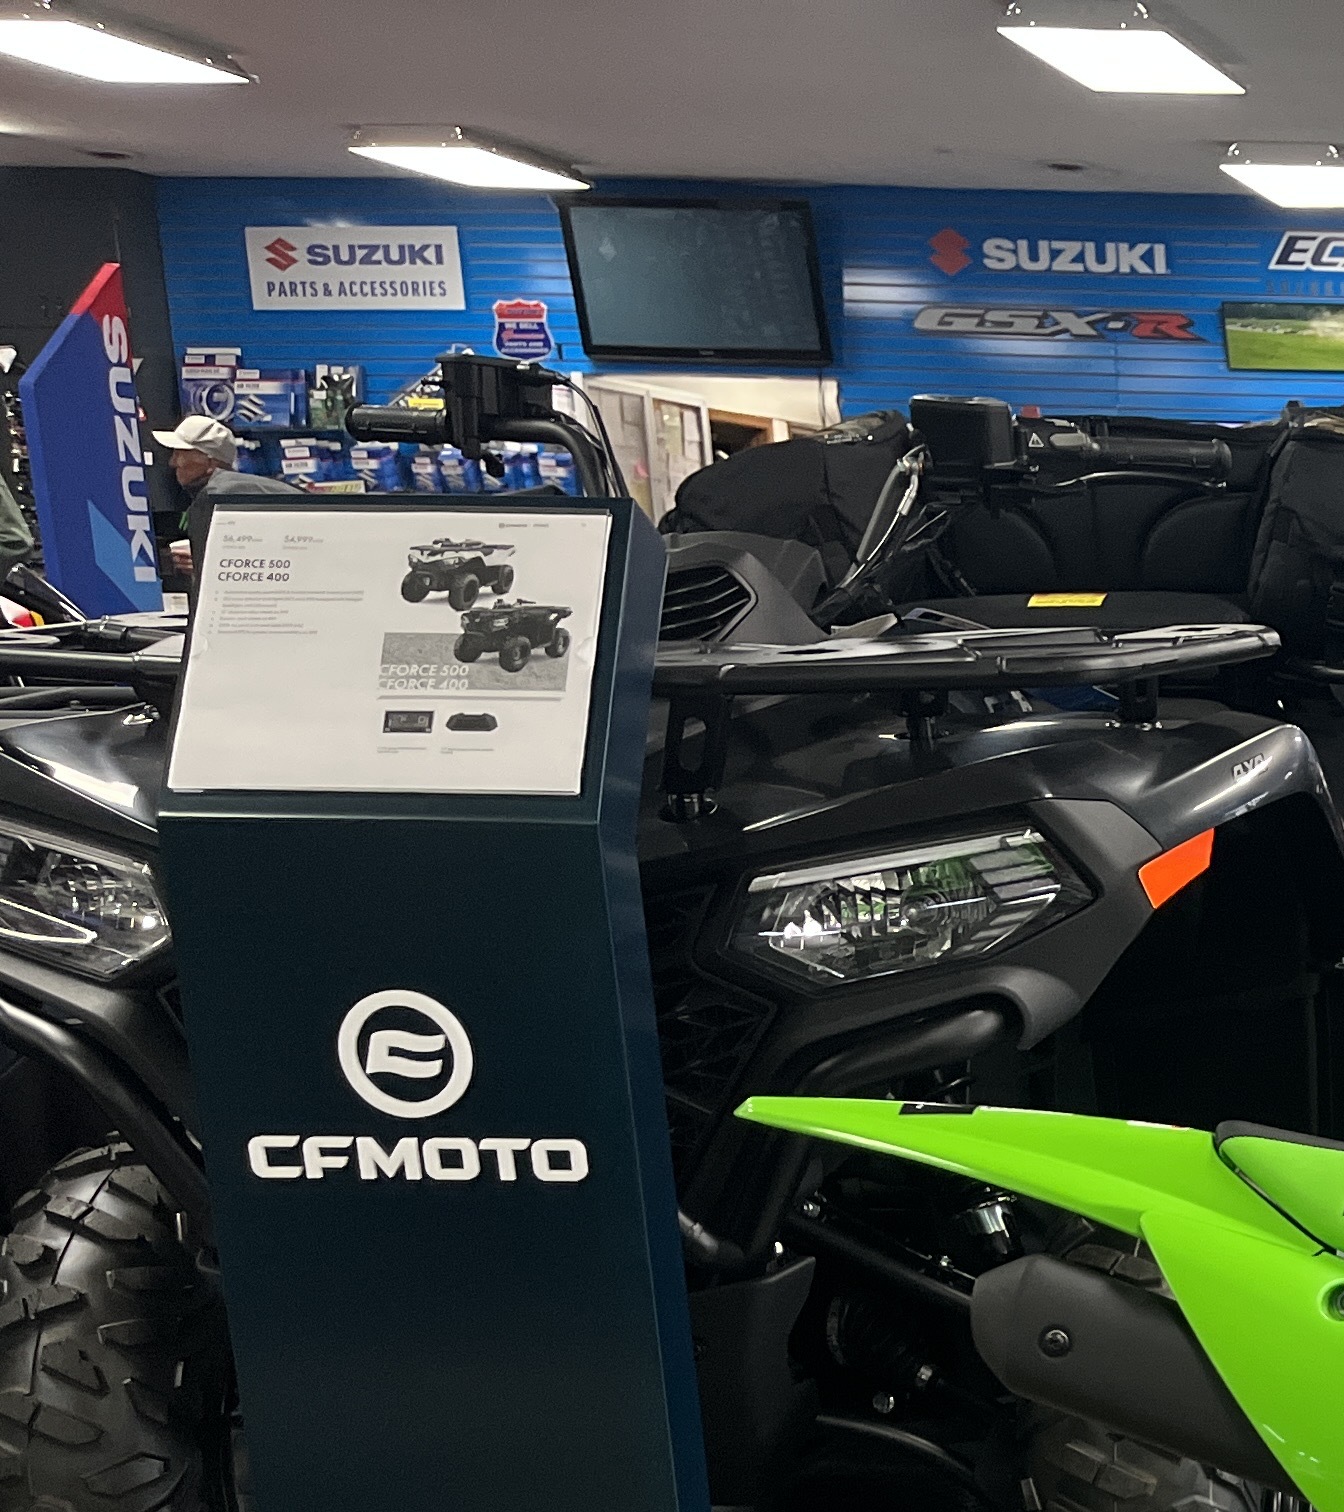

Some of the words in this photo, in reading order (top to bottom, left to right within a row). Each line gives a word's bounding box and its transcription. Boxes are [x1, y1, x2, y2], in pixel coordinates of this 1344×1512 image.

[306, 243, 444, 266] SUZUKI
[982, 237, 1168, 274] SUZUKI
[266, 280, 318, 298] PARTS
[323, 283, 332, 297] &
[338, 280, 447, 298] ACCESSORIES
[913, 307, 1205, 341] GSX-R
[102, 314, 157, 583] SUZUKI
[219, 558, 266, 569] CFORCE
[268, 559, 291, 569] 500
[217, 571, 264, 582] CFORCE
[266, 572, 290, 582] 400
[378, 664, 437, 676] CFORCE
[439, 664, 469, 676] 500
[377, 678, 435, 691] CFORCE
[439, 678, 469, 691] 400
[247, 1135, 589, 1183] CFMOTO
